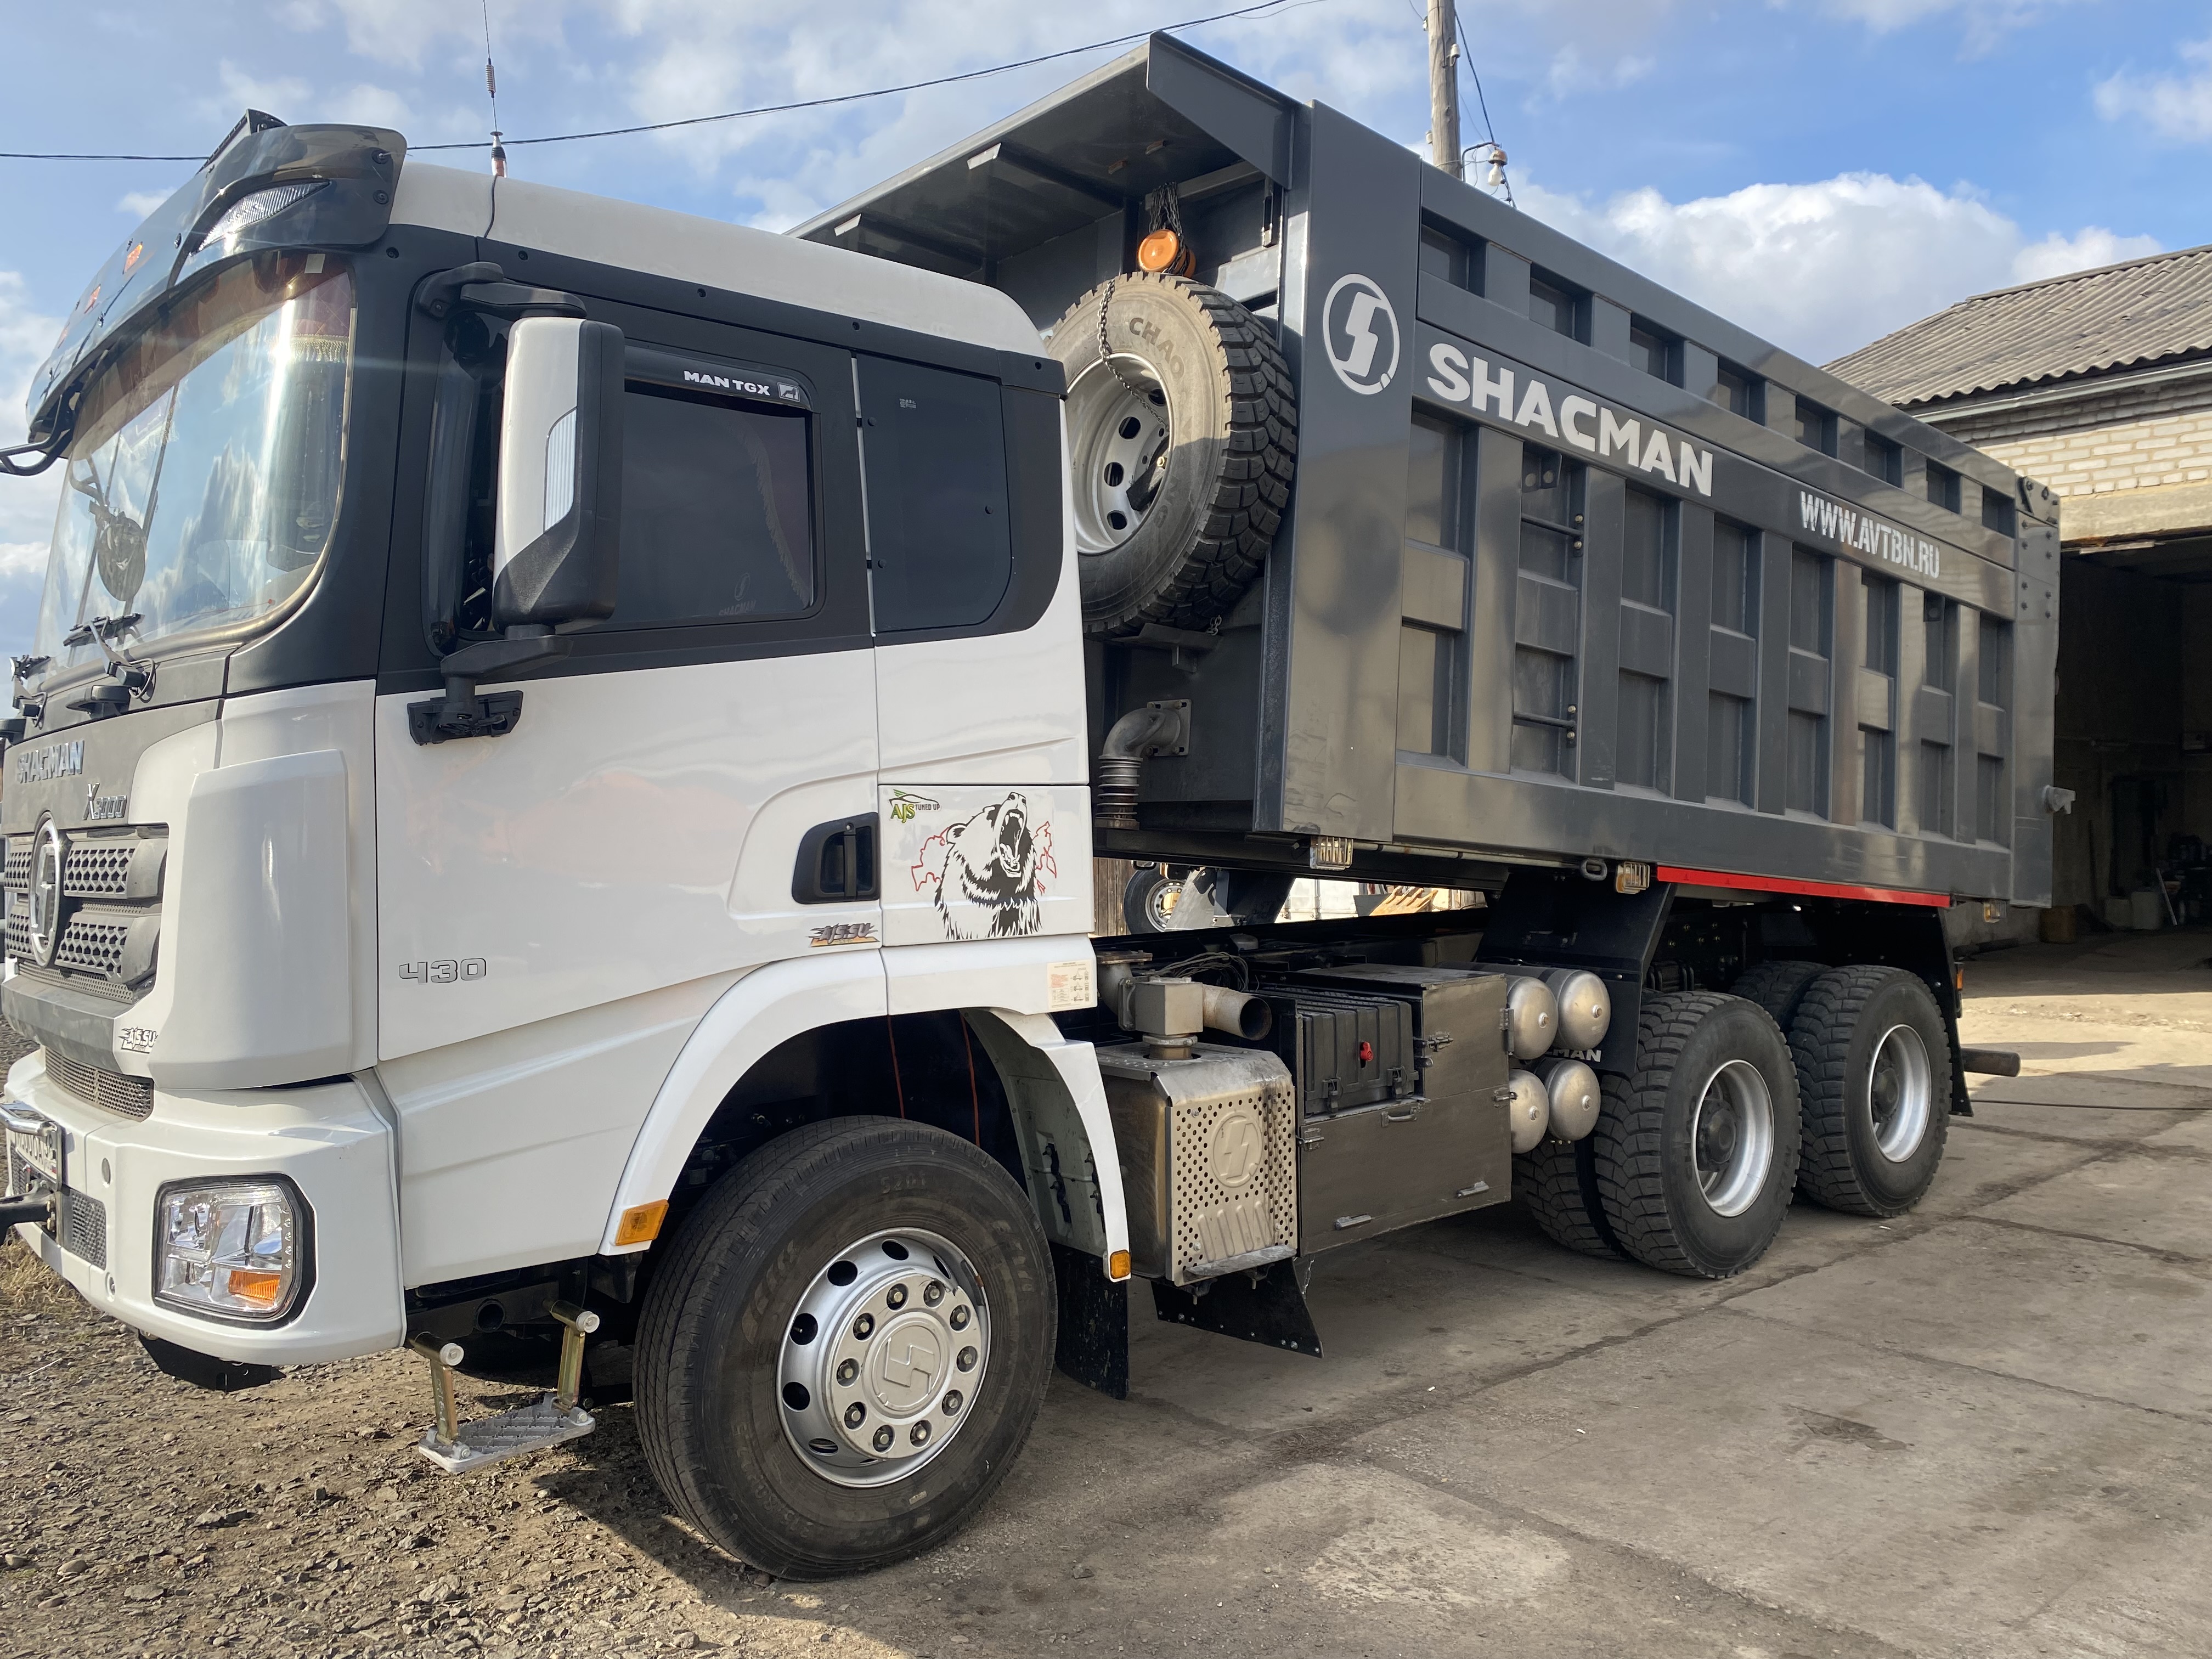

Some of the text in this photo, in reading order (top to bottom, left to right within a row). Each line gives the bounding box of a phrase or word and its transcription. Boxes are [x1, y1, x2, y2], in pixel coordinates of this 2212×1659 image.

[1129, 317, 1185, 382] CHAO
[684, 370, 770, 396] MAN TGX
[1427, 343, 1713, 496] SHACMAN
[1797, 490, 1940, 579] WWW.AVTBN.RU
[17, 740, 84, 783] SHACMAN
[82, 783, 127, 820] X3000
[890, 803, 916, 823] AJS
[399, 958, 487, 985] 430
[1547, 1048, 1601, 1062] MAN
